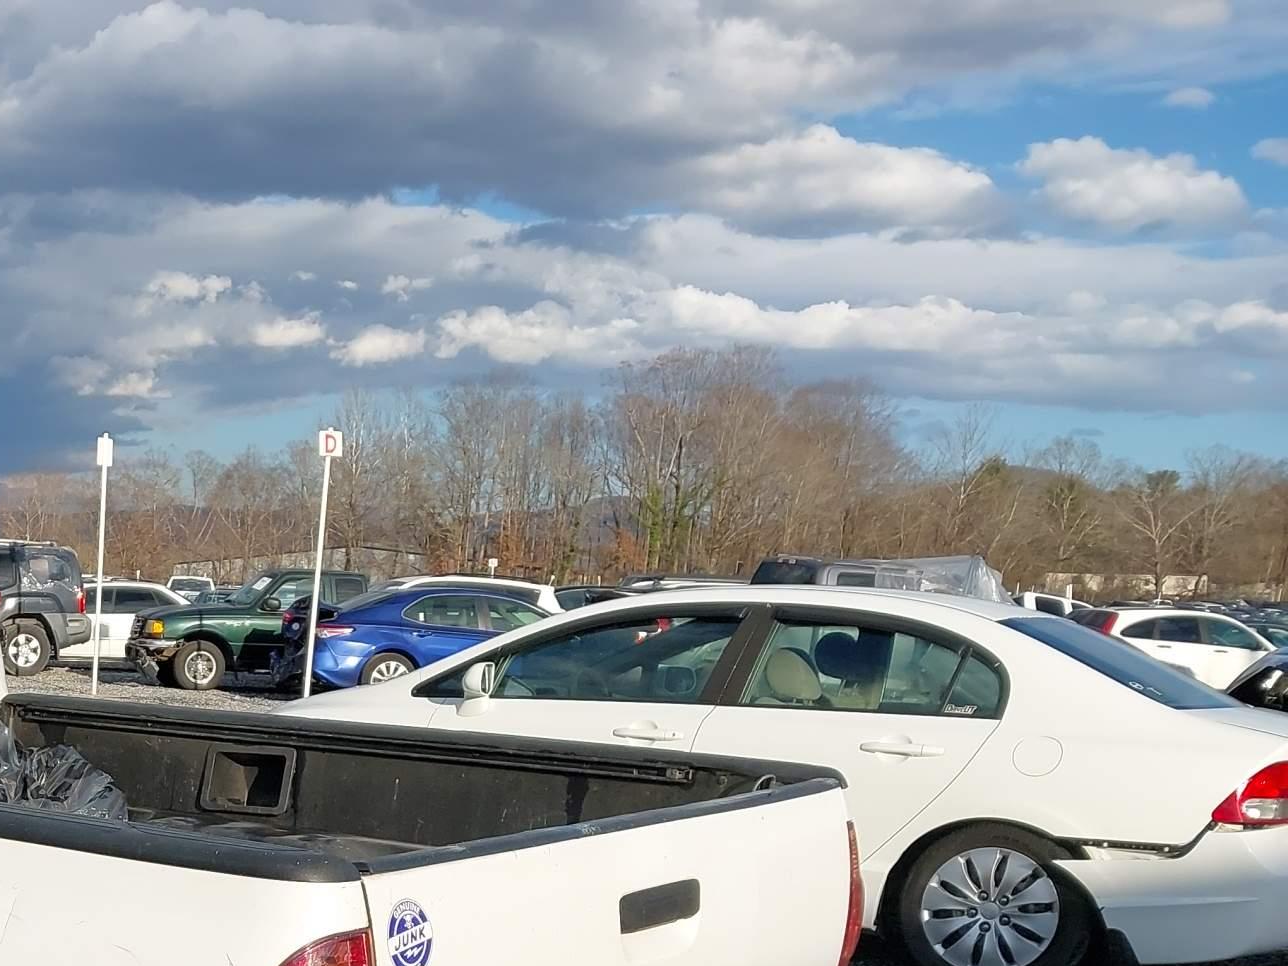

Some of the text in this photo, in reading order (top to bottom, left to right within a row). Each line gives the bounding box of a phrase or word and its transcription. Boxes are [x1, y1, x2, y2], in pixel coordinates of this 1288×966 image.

[325, 434, 337, 453] D
[394, 902, 420, 919] GENUINE
[394, 926, 426, 951] JUNK
